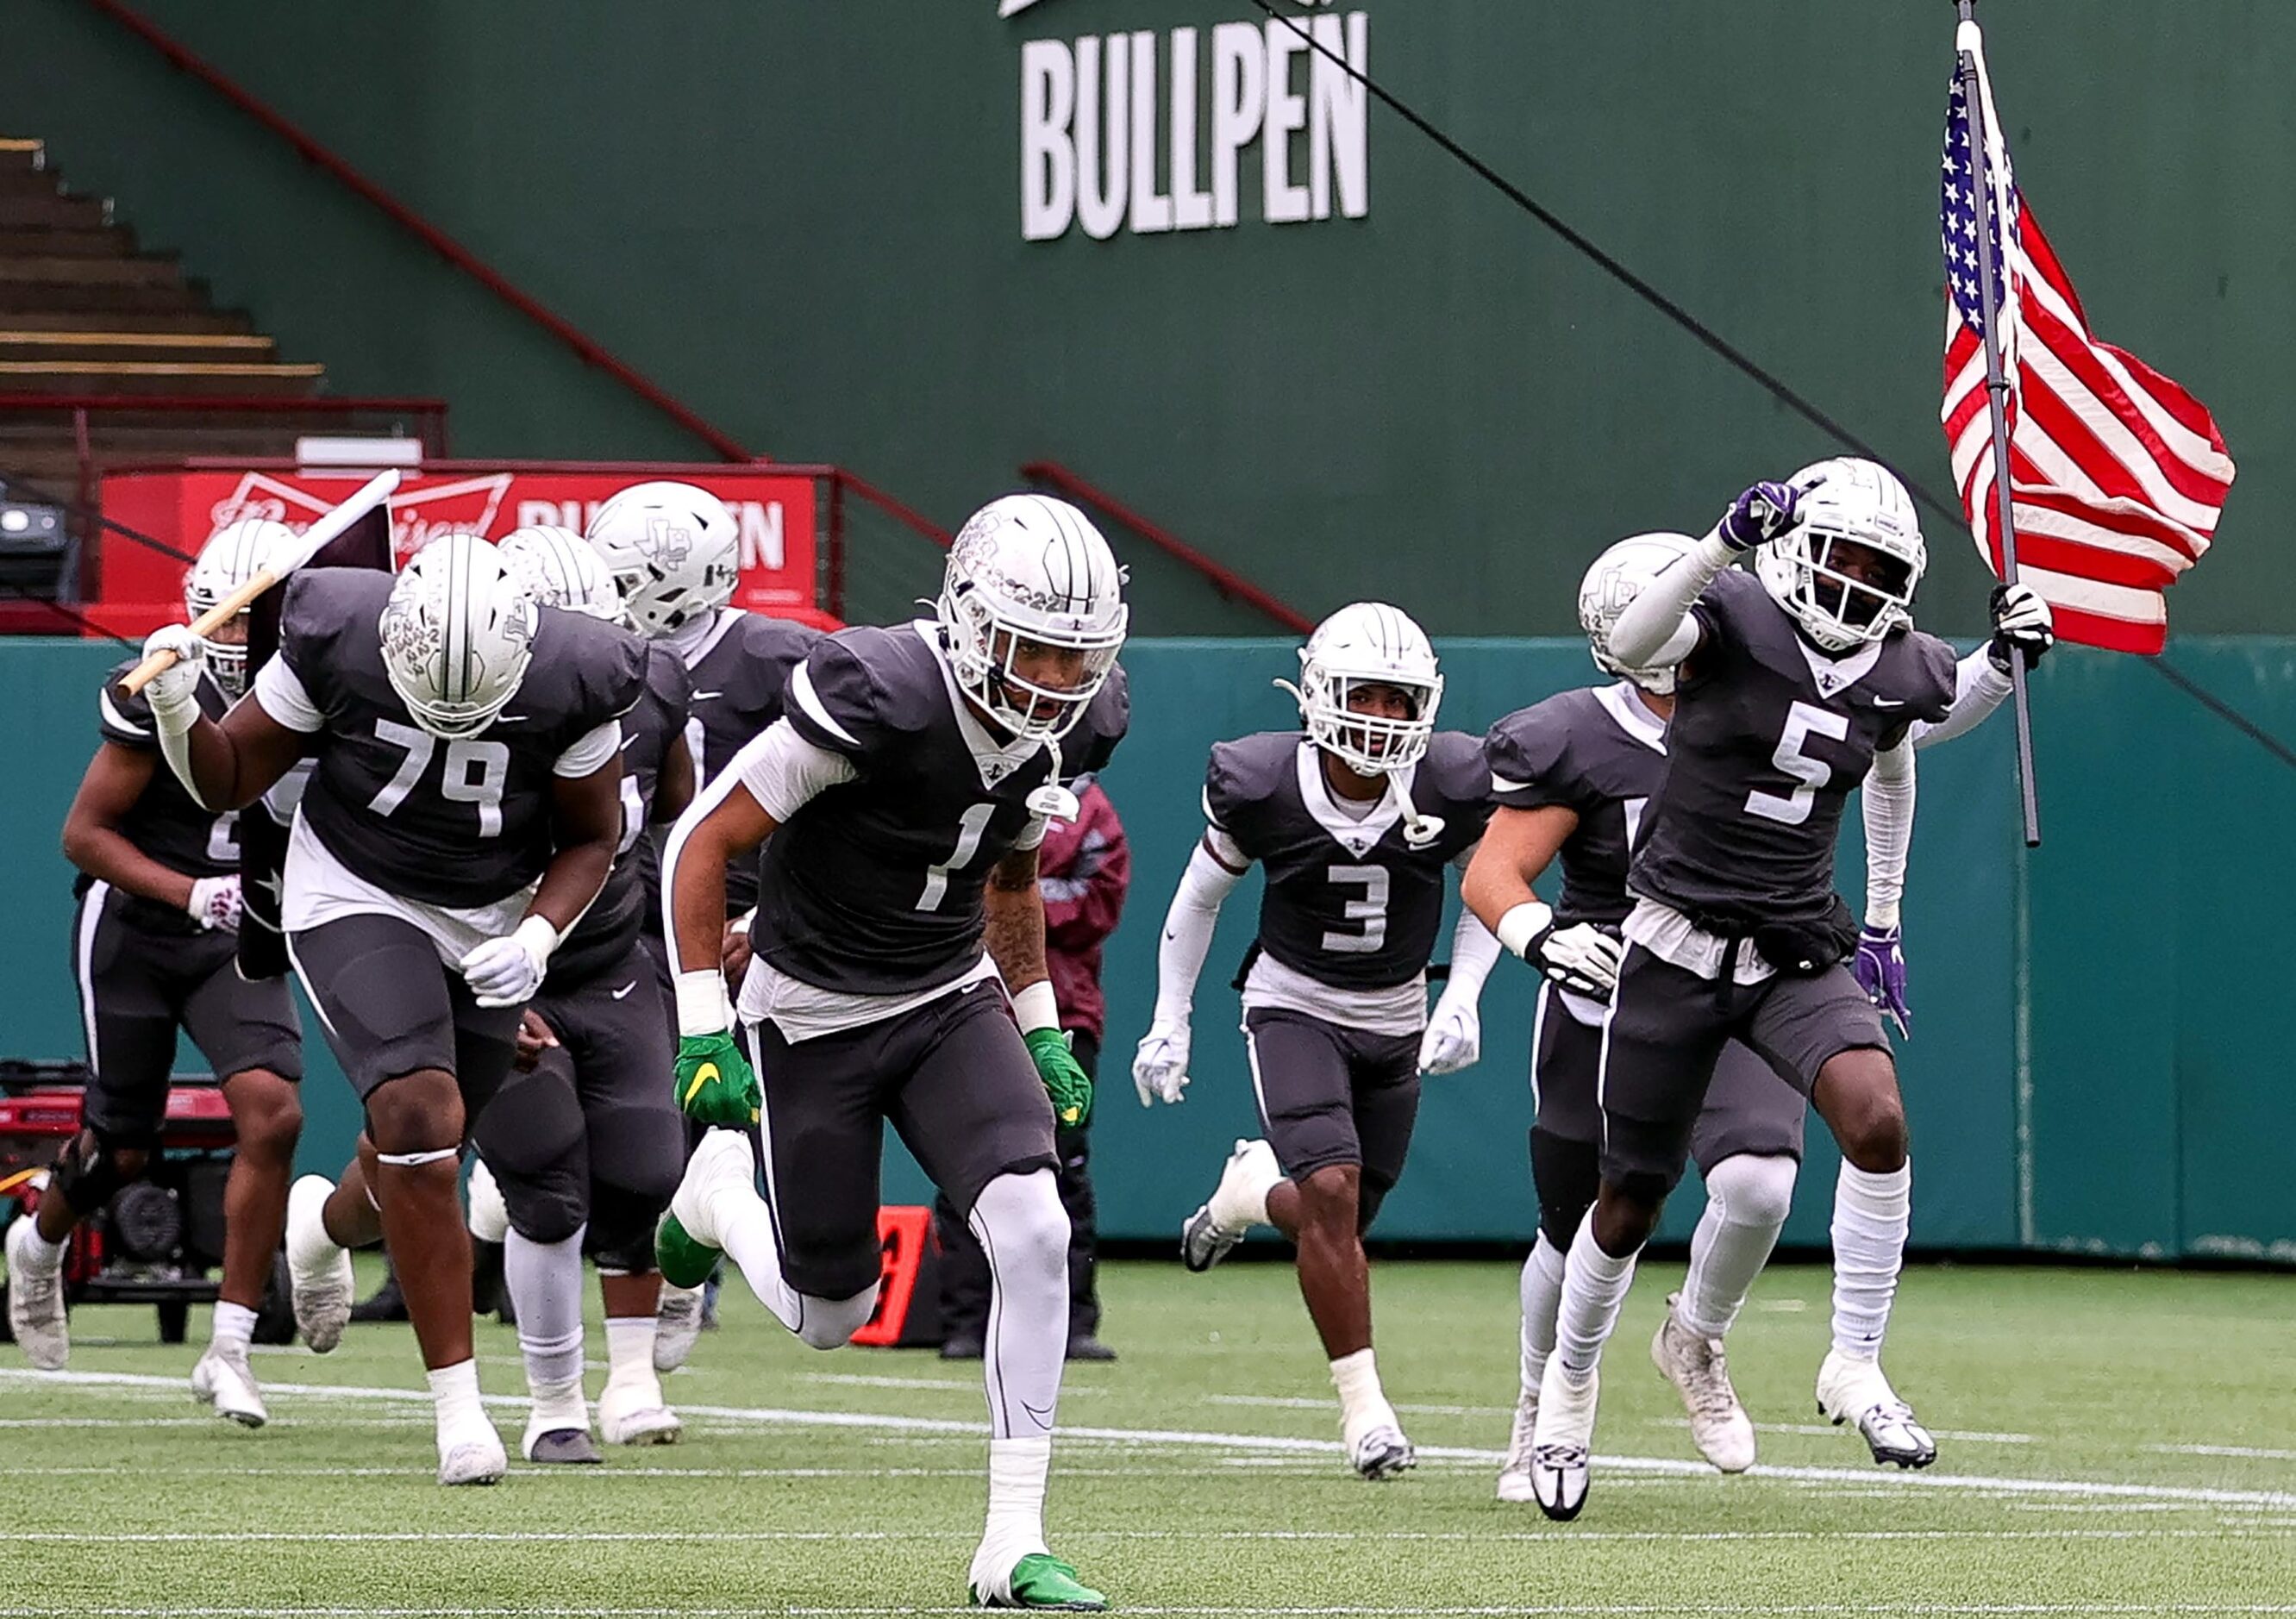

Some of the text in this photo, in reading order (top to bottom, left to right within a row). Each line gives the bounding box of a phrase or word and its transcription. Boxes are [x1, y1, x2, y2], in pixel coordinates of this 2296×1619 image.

[1022, 11, 1369, 241] BULLPEN
[368, 718, 510, 838] 79
[1743, 701, 1849, 825] 5
[915, 803, 996, 910] 1
[1322, 865, 1391, 953] 3
